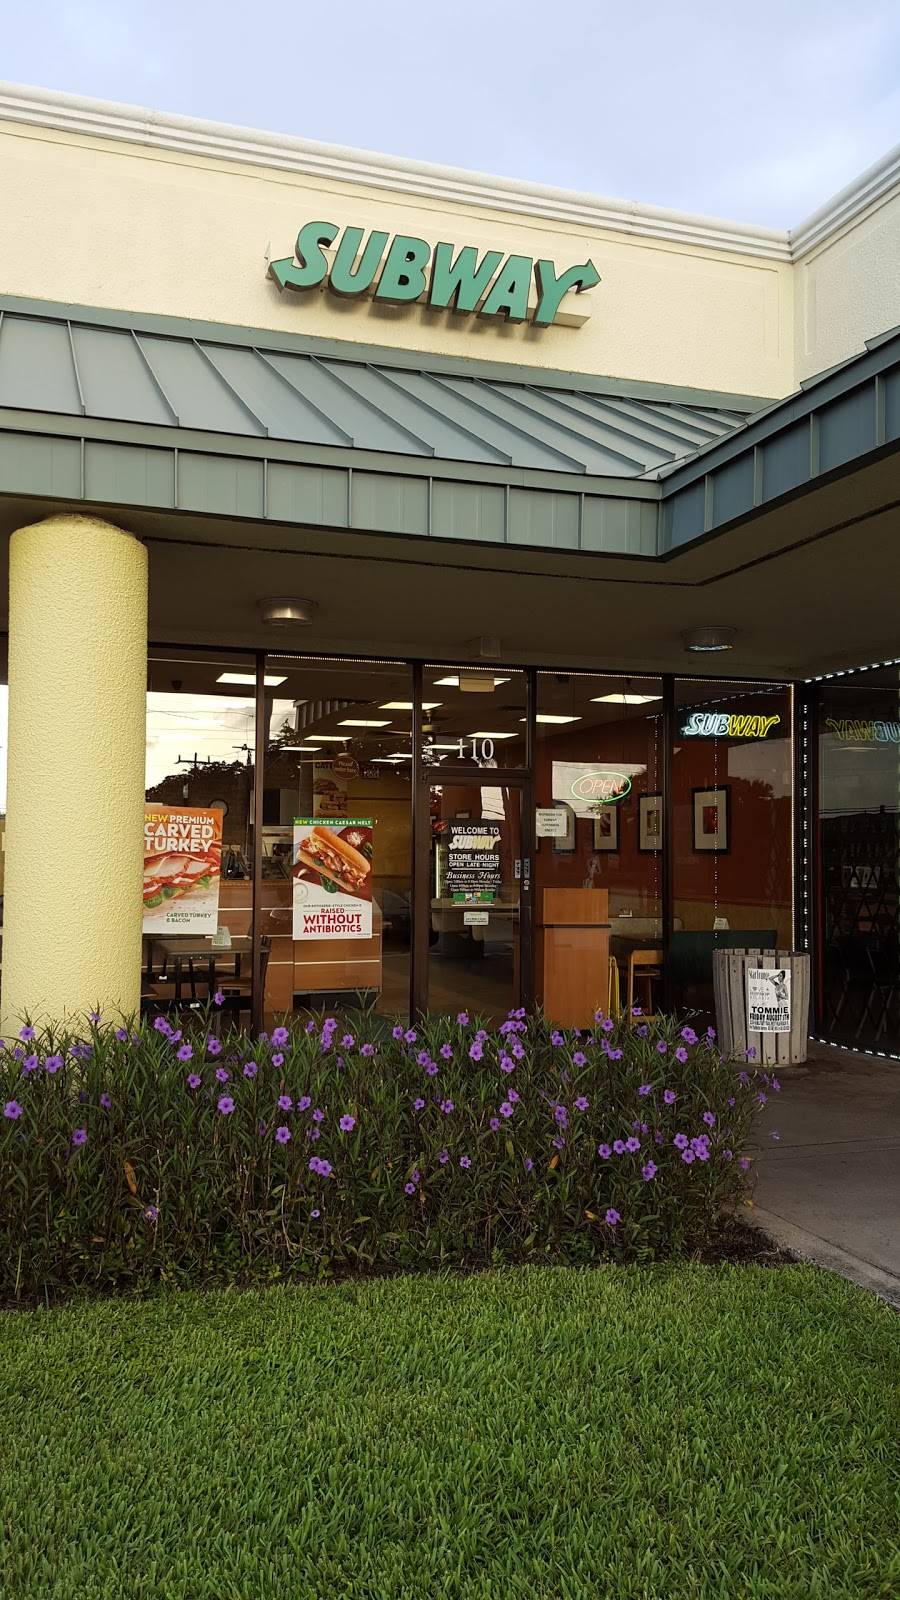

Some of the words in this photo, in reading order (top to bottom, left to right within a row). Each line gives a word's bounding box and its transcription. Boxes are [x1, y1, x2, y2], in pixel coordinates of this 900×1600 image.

[268, 221, 601, 328] SUBWAY
[680, 712, 780, 737] SUBWAY
[457, 738, 494, 760] 110
[580, 778, 624, 794] OPEN
[144, 814, 168, 822] NEW
[169, 815, 214, 824] PREMIUM
[144, 822, 214, 838] CARVED
[144, 836, 213, 852] TURKEY
[448, 834, 501, 850] SUBWAY
[303, 914, 362, 924] WITHOUT
[303, 924, 362, 933] ANTIBIOTICS
